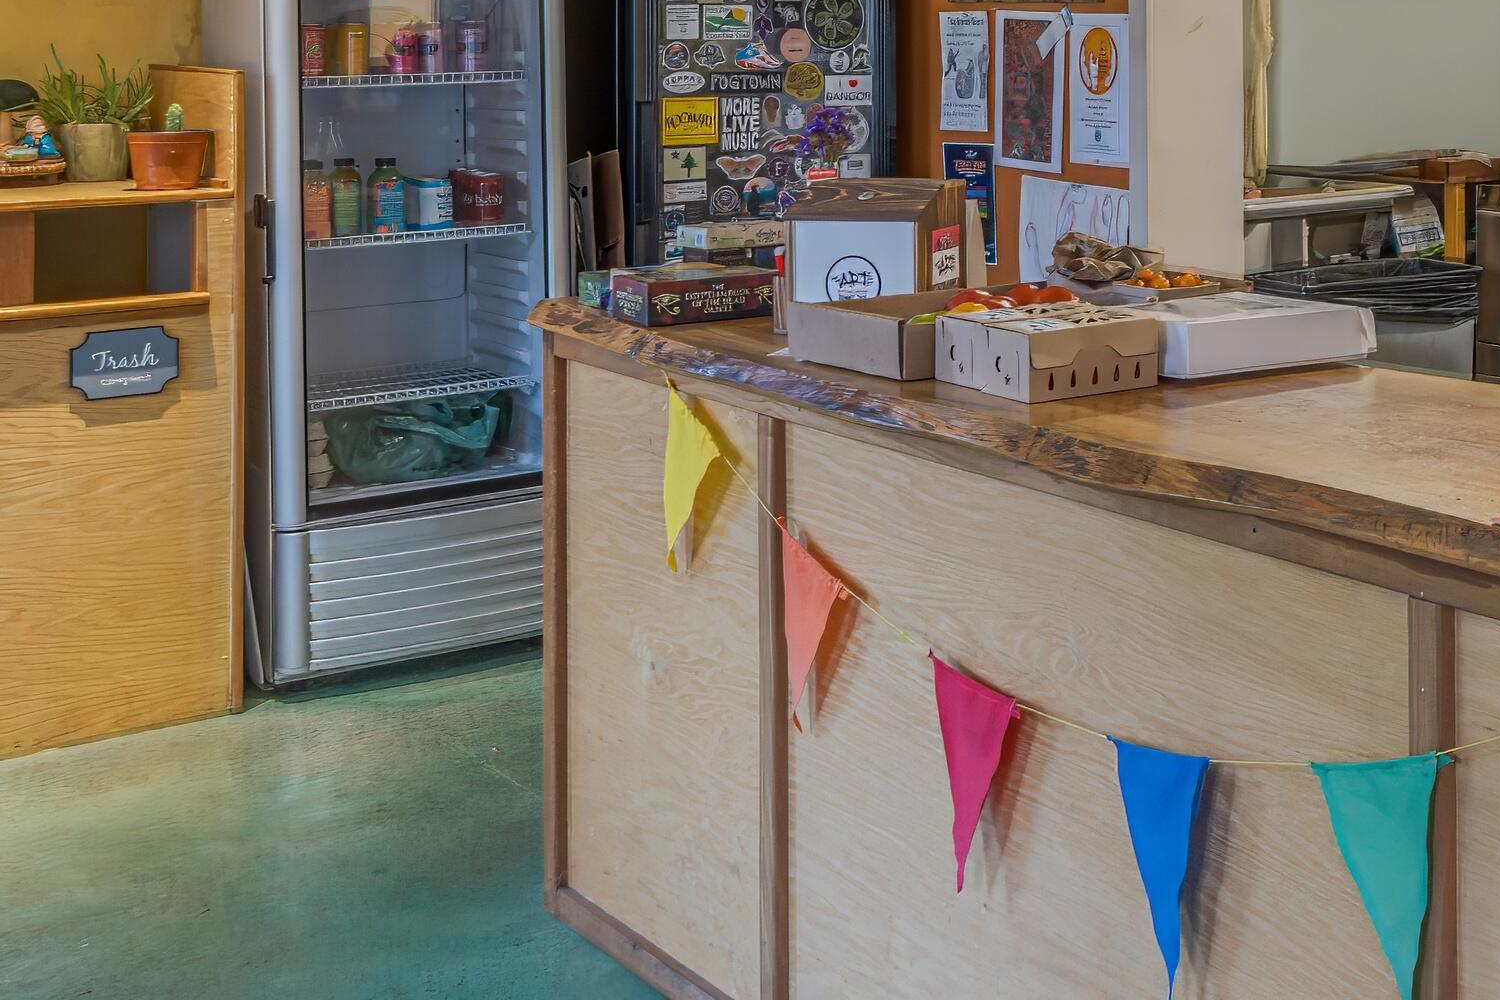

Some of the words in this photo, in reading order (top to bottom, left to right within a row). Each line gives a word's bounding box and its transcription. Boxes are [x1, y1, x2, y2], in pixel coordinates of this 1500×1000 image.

[721, 97, 760, 116] MORE
[722, 116, 760, 132] LIVE
[721, 132, 760, 150] MUSIC
[839, 271, 867, 288] ART
[92, 343, 159, 372] Trash
